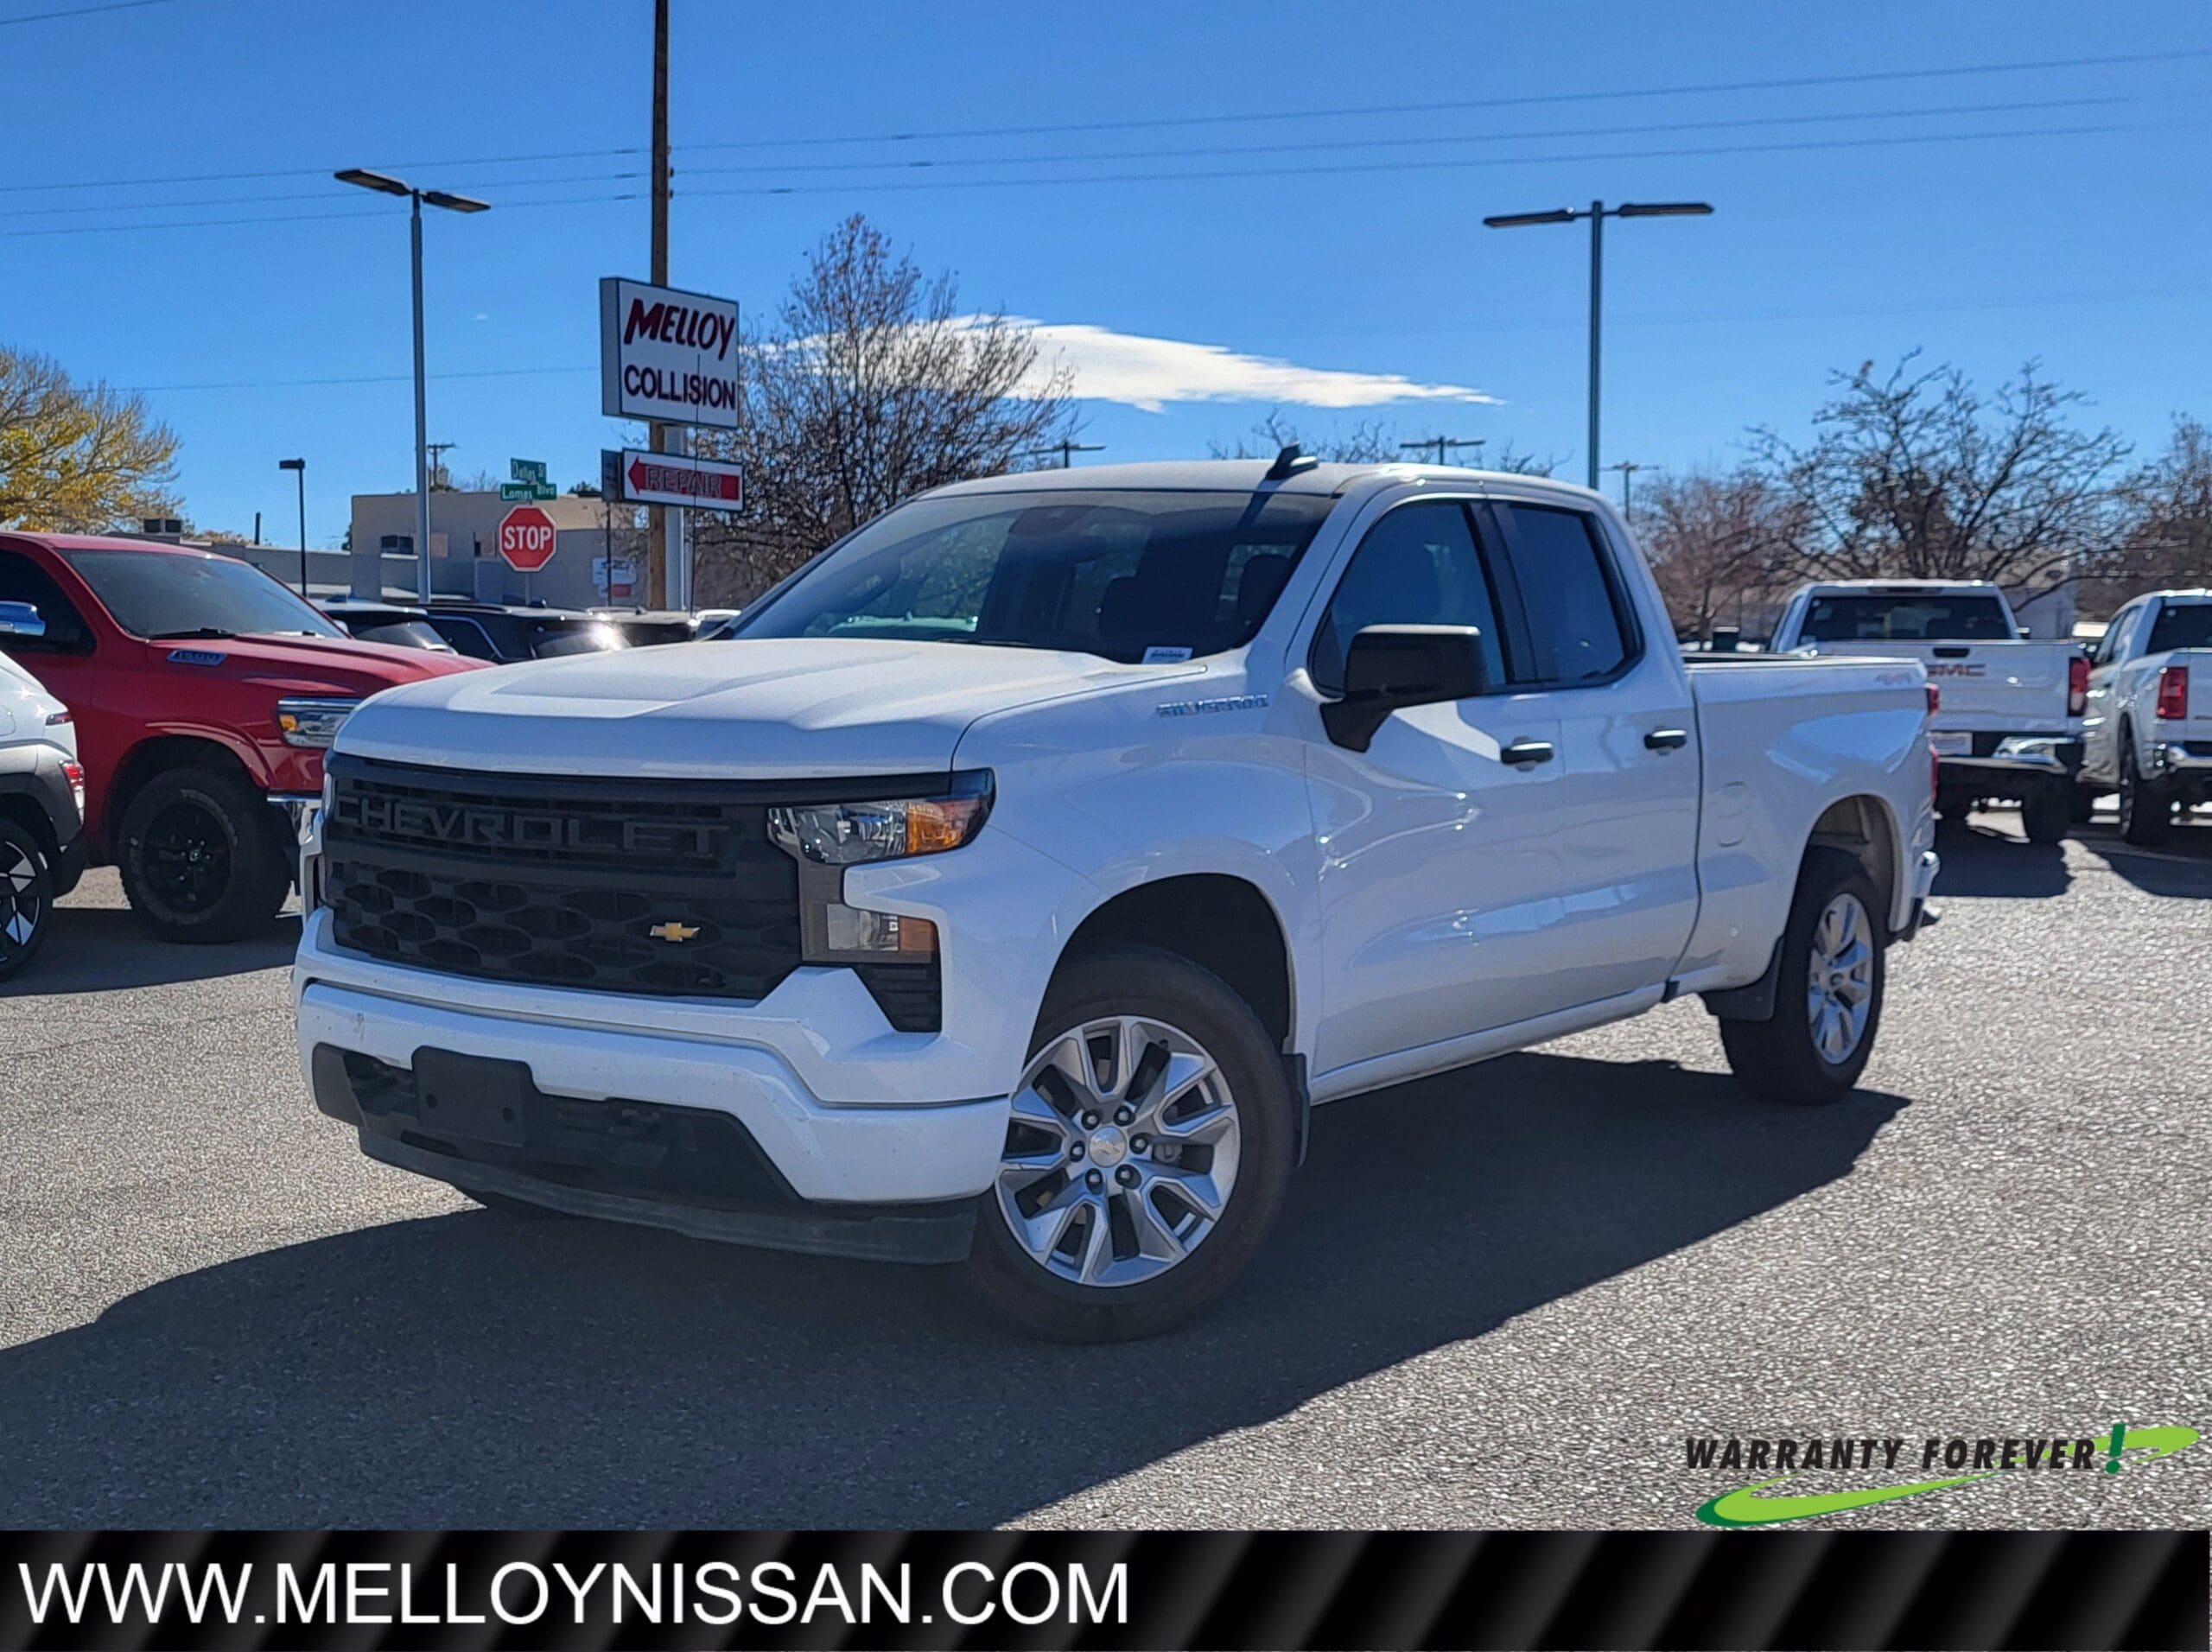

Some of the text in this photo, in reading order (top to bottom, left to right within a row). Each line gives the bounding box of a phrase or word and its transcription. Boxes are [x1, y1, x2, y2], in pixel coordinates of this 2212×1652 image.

[624, 298, 735, 361] MELLOY
[624, 365, 735, 410] COLLISION
[647, 467, 722, 499] REPAIR
[504, 525, 551, 550] STOP
[334, 794, 729, 858] CHEVROLET
